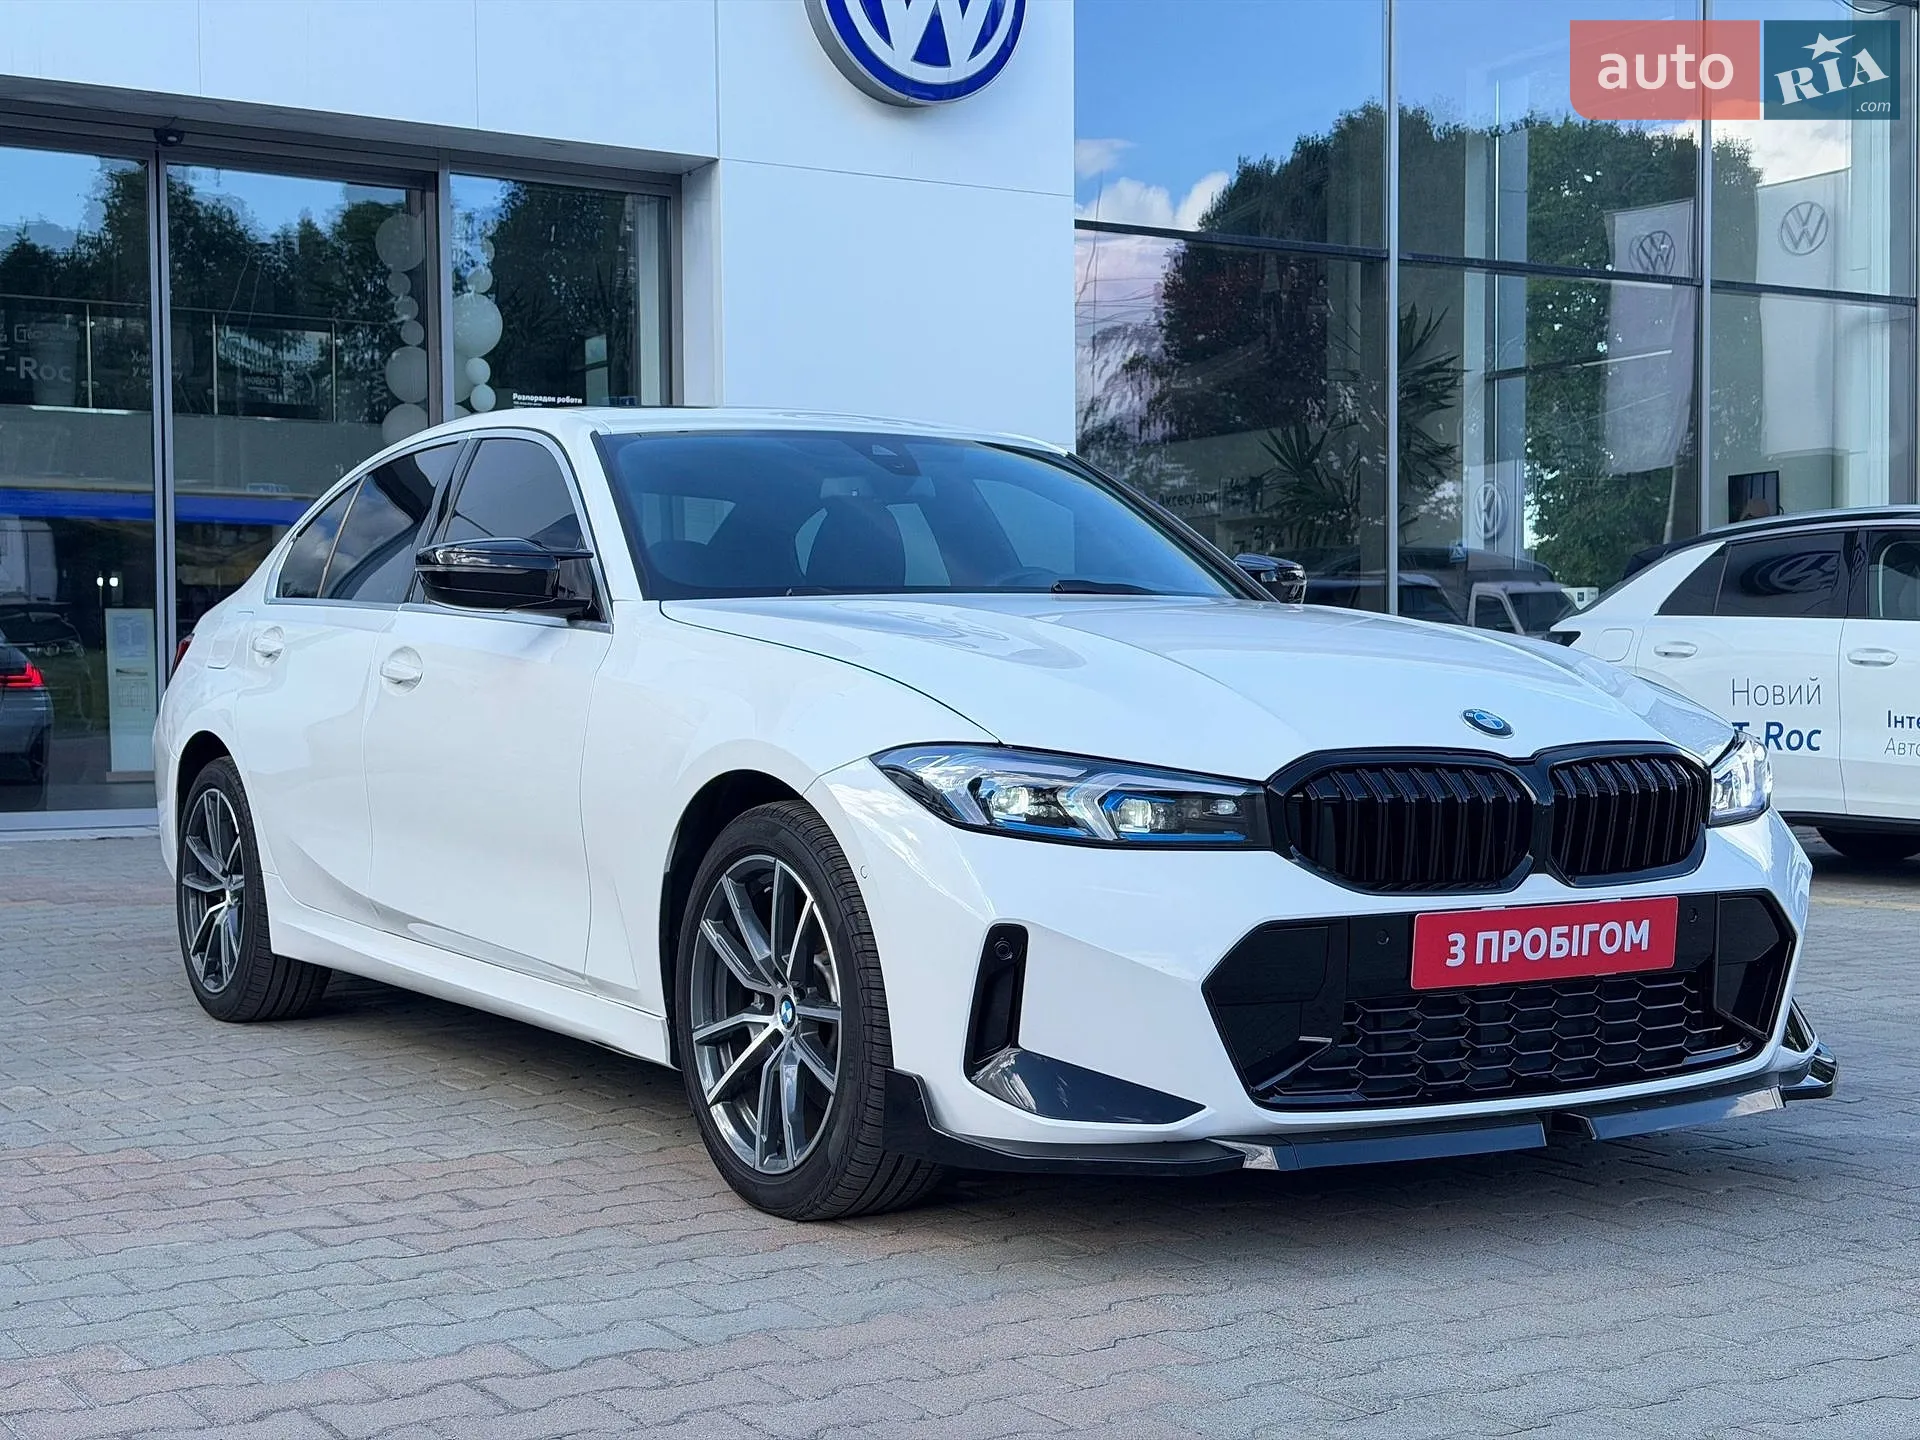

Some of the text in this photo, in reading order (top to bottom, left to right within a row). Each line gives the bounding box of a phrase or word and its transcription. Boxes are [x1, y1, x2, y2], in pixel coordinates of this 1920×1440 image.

[0, 355, 73, 384] -Roc
[1731, 676, 1822, 706] Новий
[1475, 919, 1650, 965] ПРОБІГОМ
